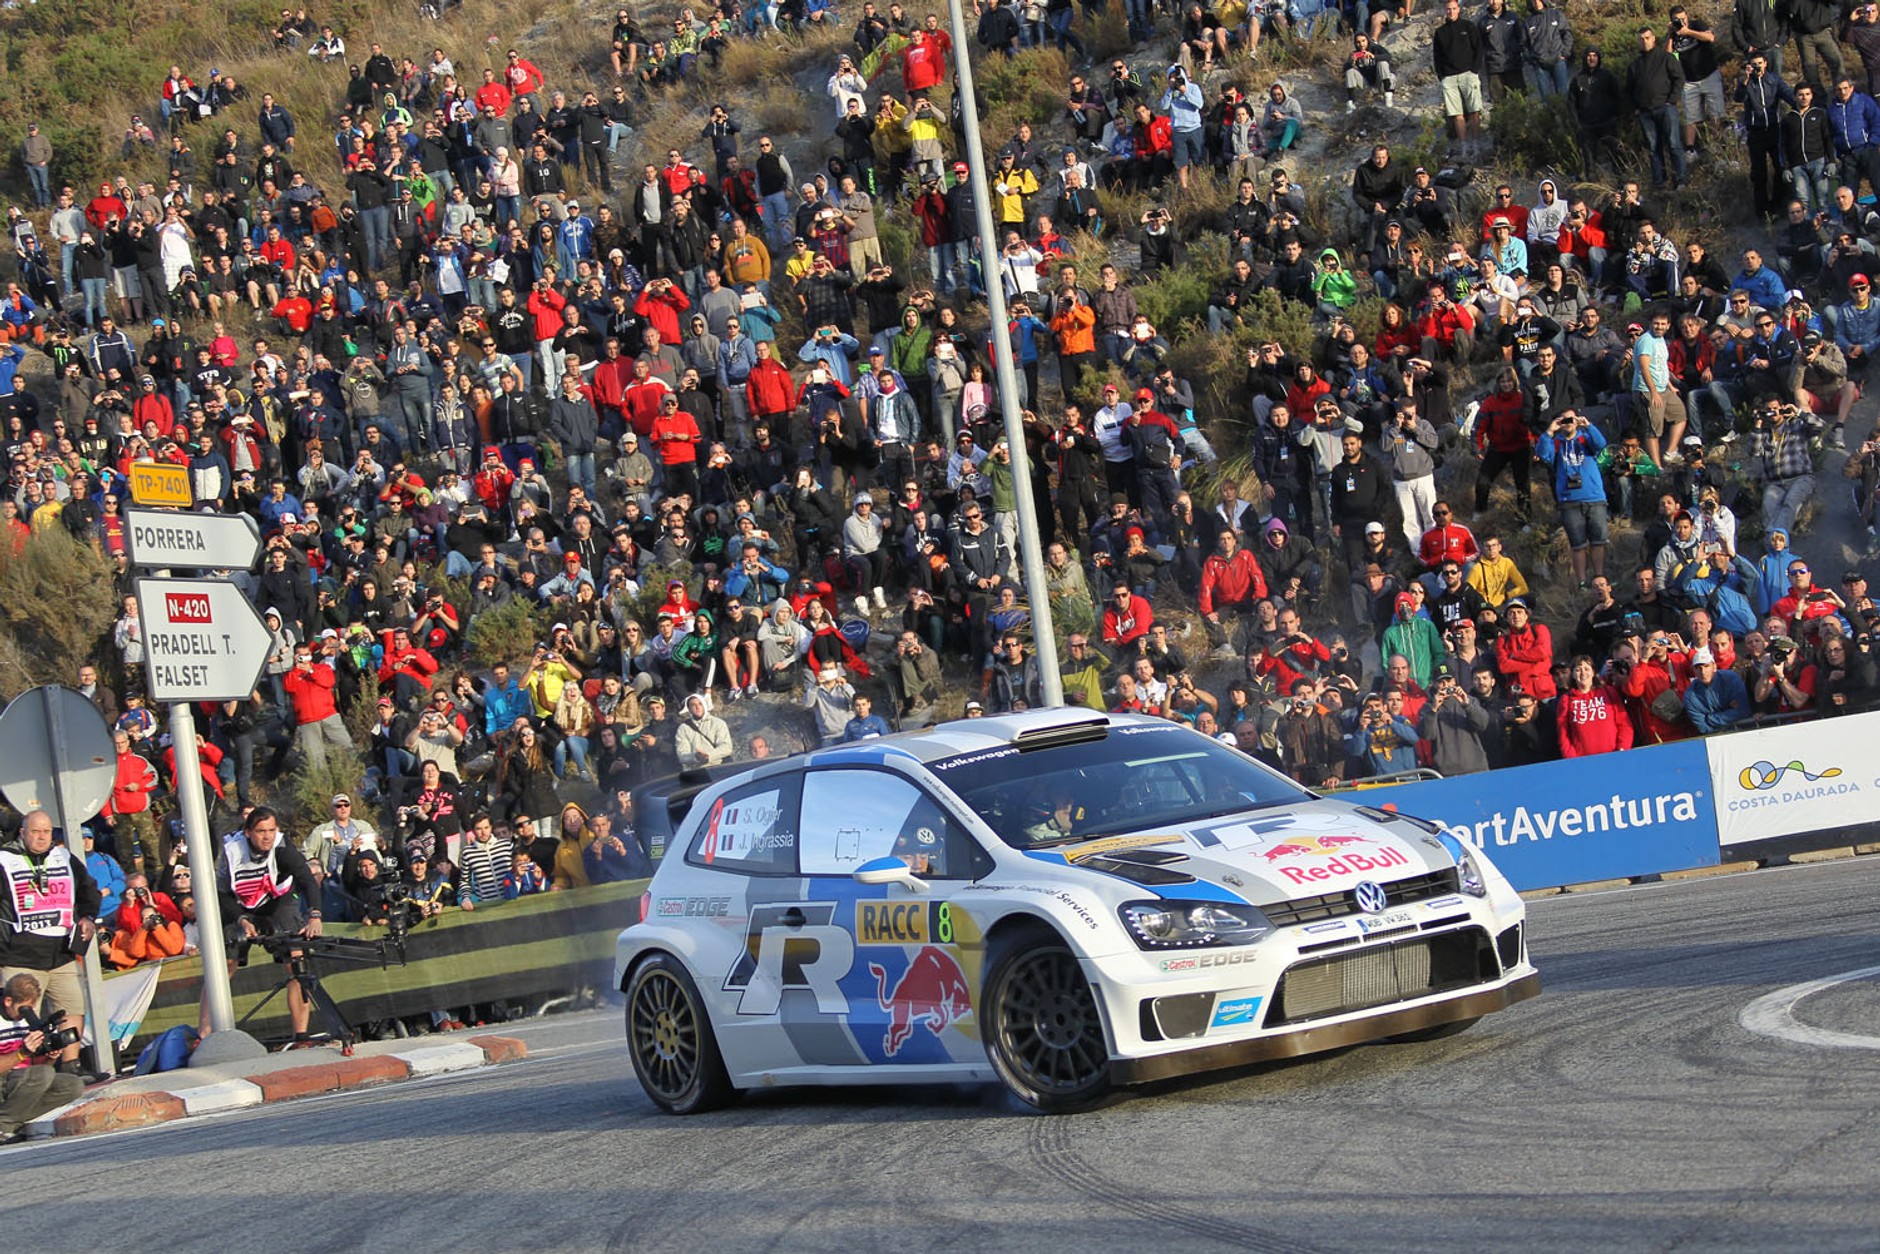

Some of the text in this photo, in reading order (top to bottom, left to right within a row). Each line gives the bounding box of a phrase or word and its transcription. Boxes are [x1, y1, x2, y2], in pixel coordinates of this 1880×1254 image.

[138, 474, 187, 495] TP-7401
[135, 526, 206, 551] PORRERA
[168, 599, 209, 618] N-420
[151, 633, 236, 655] PRADELL T.
[155, 665, 208, 687] FALSET
[1572, 696, 1606, 710] TEAM
[1572, 706, 1607, 722] 1976
[935, 747, 1020, 771] Volkswagen
[1728, 795, 1779, 812] COSTA
[1782, 781, 1860, 803] DAURADA
[743, 804, 784, 827] S. Ogier
[705, 797, 724, 865] 8
[751, 829, 794, 853] Ingrassia
[1278, 846, 1409, 884] Red Bull
[684, 896, 732, 917] EDGE
[1056, 892, 1099, 930] Services
[23, 920, 51, 931] 2013
[863, 903, 920, 941] RACC
[938, 901, 953, 943] 8
[1168, 950, 1258, 970] Castrol EDGE
